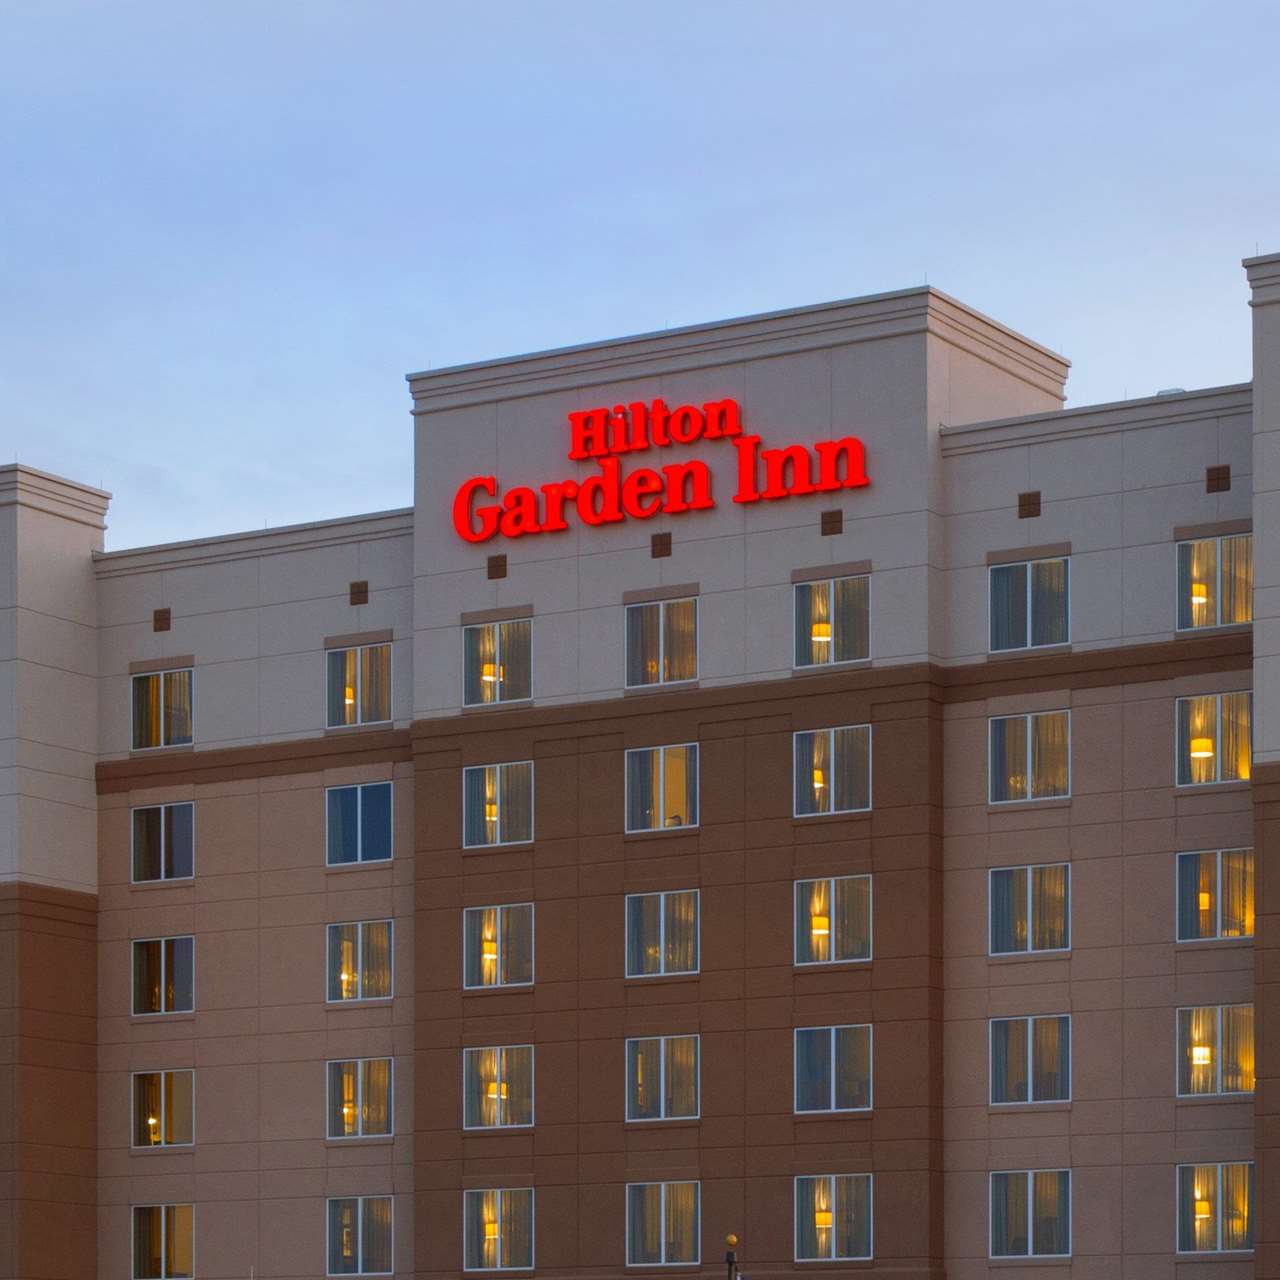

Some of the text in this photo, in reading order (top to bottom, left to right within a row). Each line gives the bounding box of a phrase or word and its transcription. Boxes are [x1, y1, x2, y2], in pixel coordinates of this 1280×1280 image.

[568, 399, 742, 459] Hilton
[452, 435, 870, 543] Garden Inn
